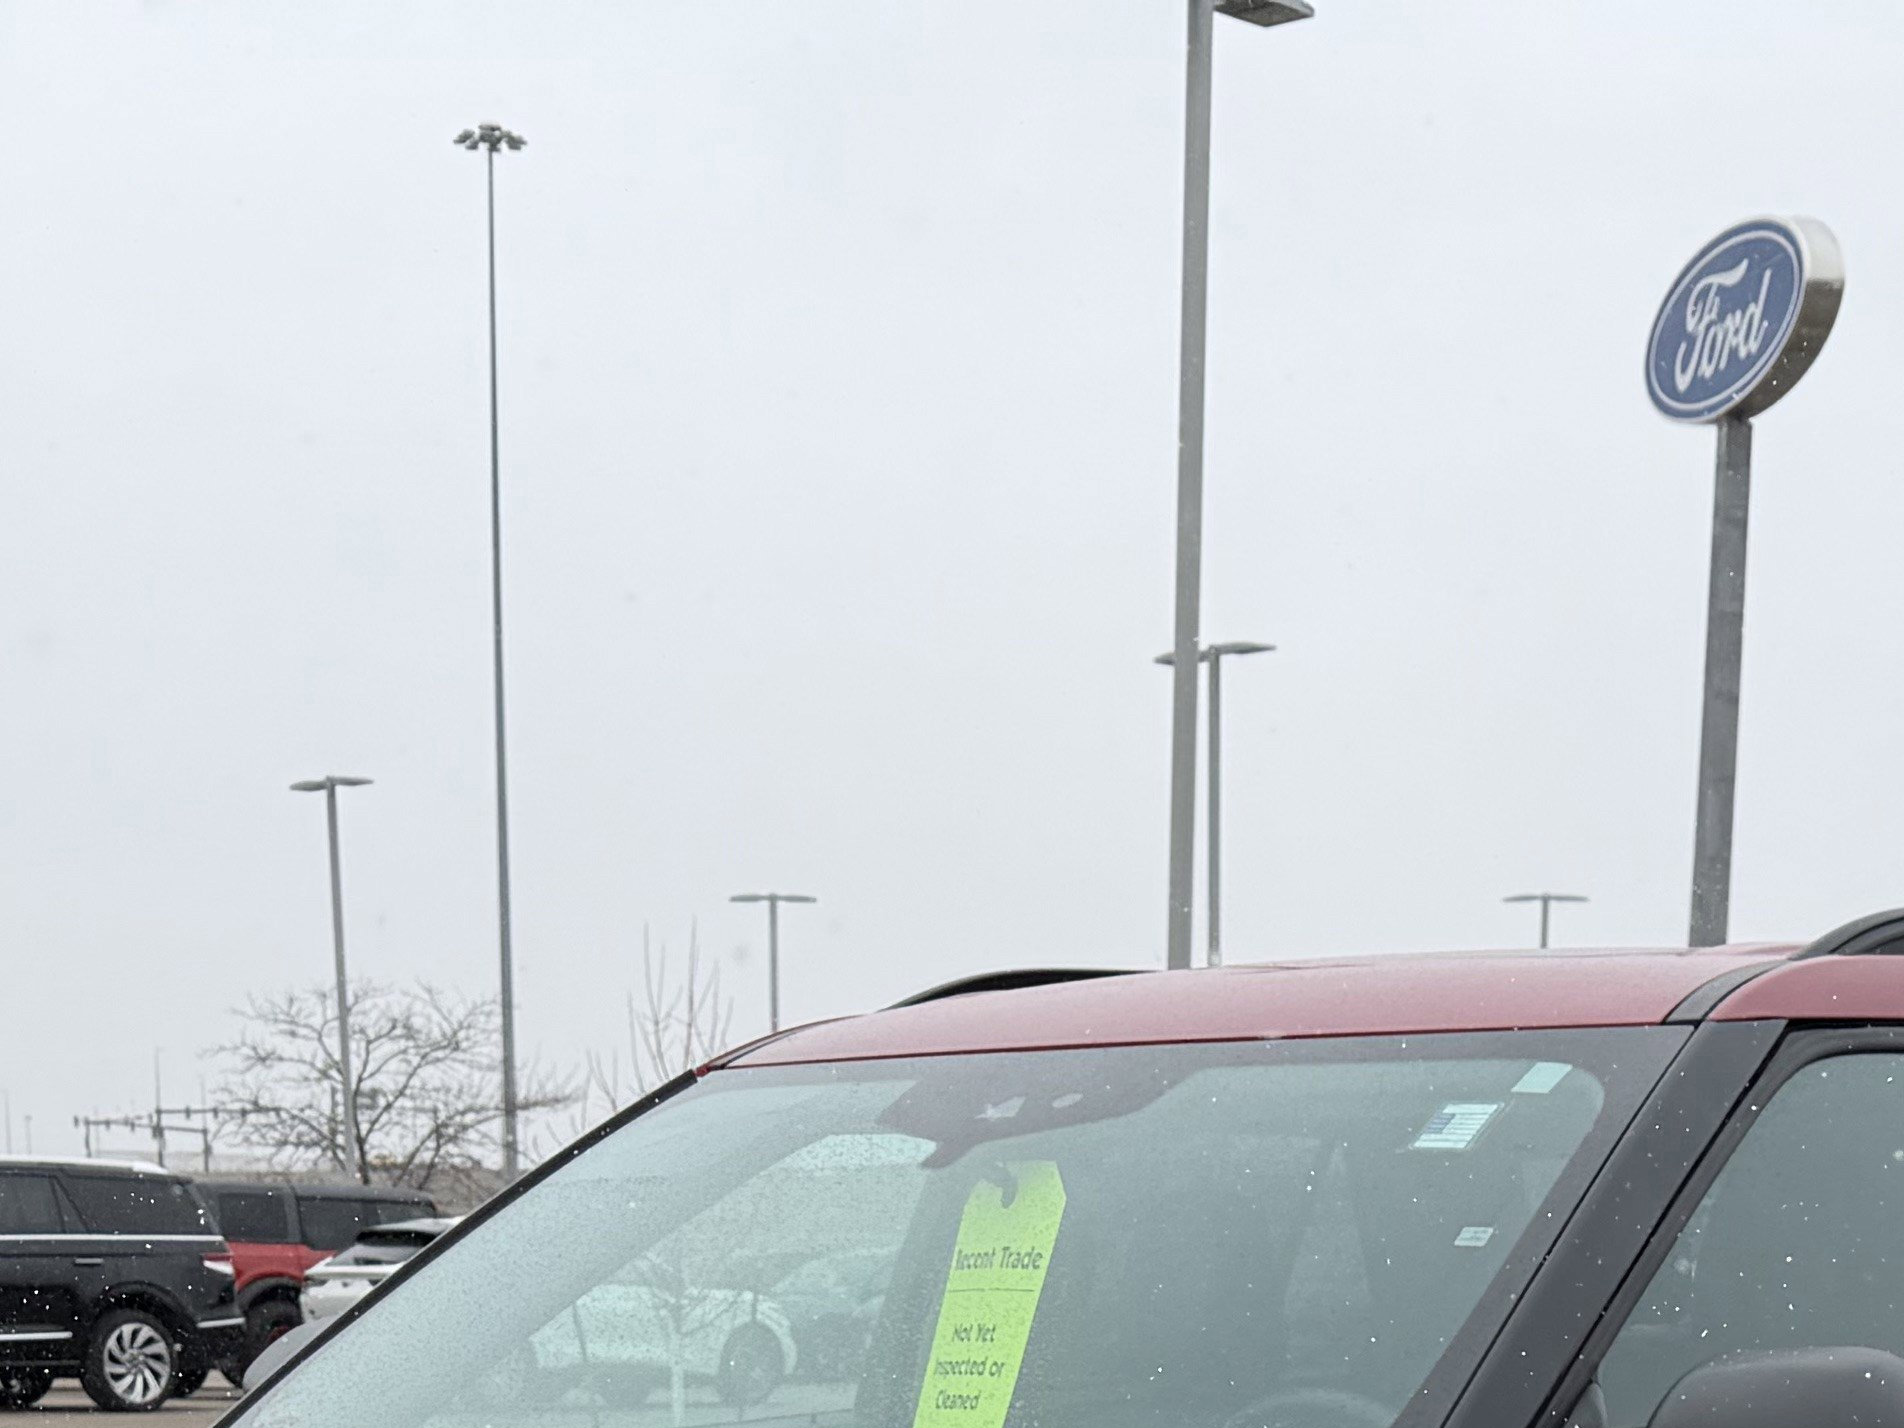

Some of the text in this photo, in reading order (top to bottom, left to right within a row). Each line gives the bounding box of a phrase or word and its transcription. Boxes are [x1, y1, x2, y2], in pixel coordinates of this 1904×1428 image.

[1674, 257, 1772, 394] Ford
[1000, 1245, 1044, 1270] Trade
[952, 1322, 996, 1343] Not Yet
[989, 1360, 1006, 1378] or
[935, 1389, 982, 1410] Cleaned
